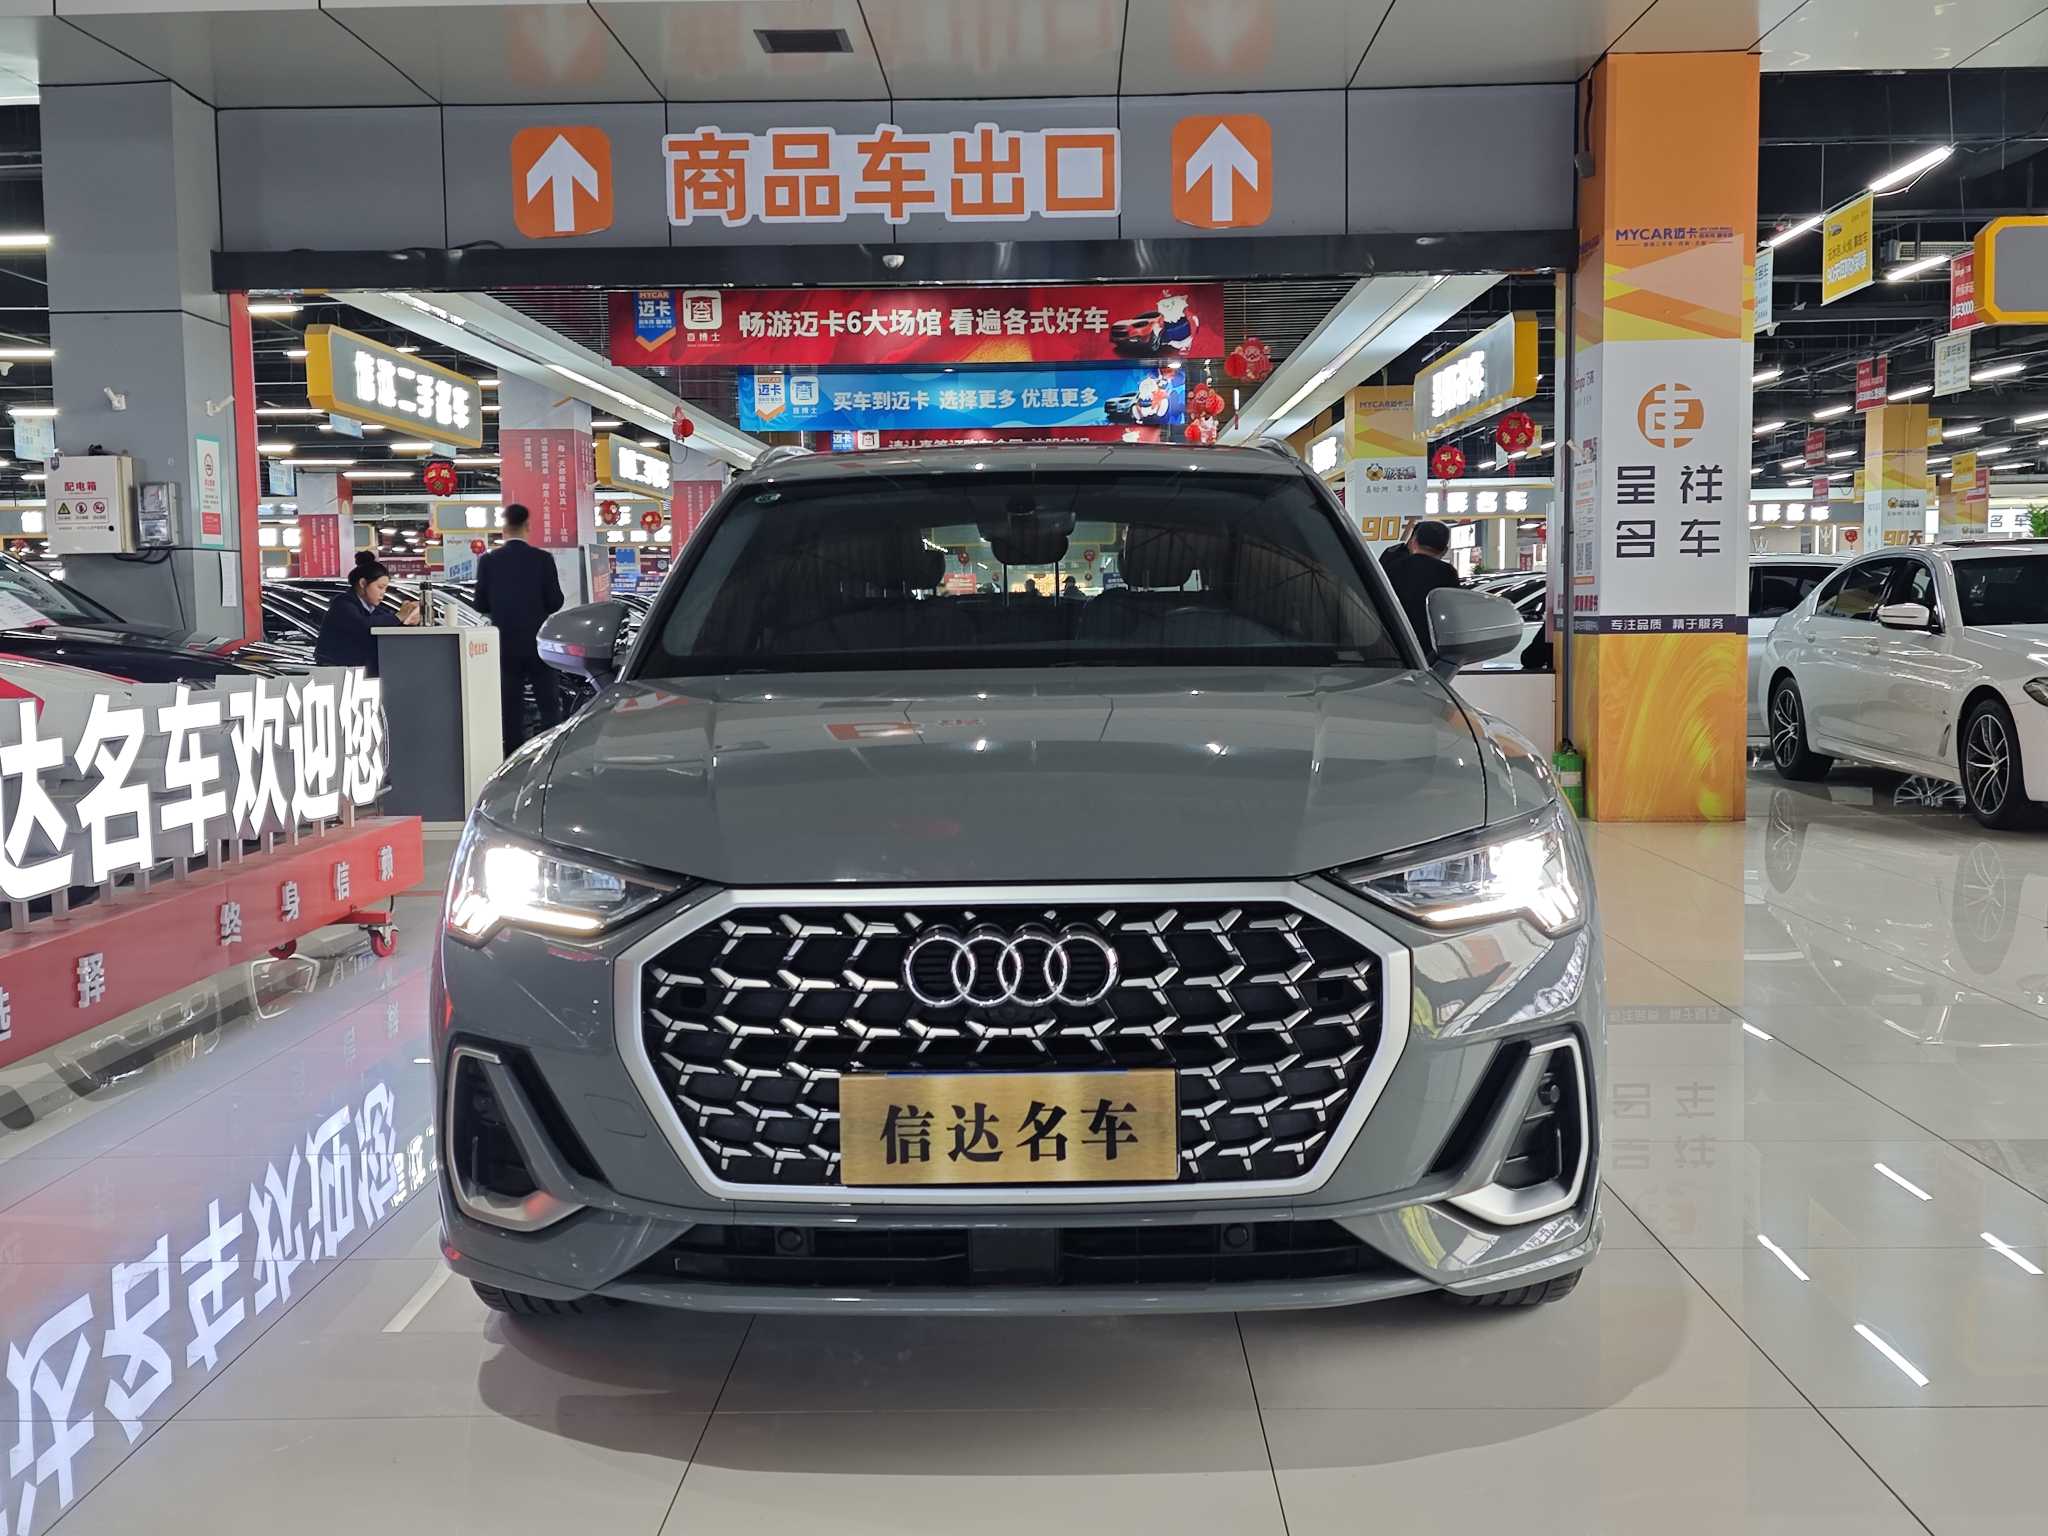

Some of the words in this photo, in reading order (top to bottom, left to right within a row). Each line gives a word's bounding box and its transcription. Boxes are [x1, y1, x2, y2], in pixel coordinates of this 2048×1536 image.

[666, 129, 1116, 221] 商品车出口
[638, 301, 671, 318] 迈卡
[738, 308, 942, 338] 畅游迈卡6大场馆
[949, 306, 1109, 337] 看遍各式好车
[758, 384, 781, 396] 迈卡
[834, 391, 930, 411] 买车到迈卡
[940, 389, 1016, 411] 选择更多
[1022, 387, 1098, 409] 优惠更多
[64, 481, 97, 492] 配电箱
[1616, 464, 1724, 505] 呈祥
[1615, 518, 1721, 558] 名车
[1884, 529, 1924, 545] 90天
[1611, 618, 1662, 631] 专注品质
[1672, 617, 1724, 630] 精于服务
[0, 667, 386, 900] 达名车欢迎您
[880, 1098, 1139, 1165] 信达名车
